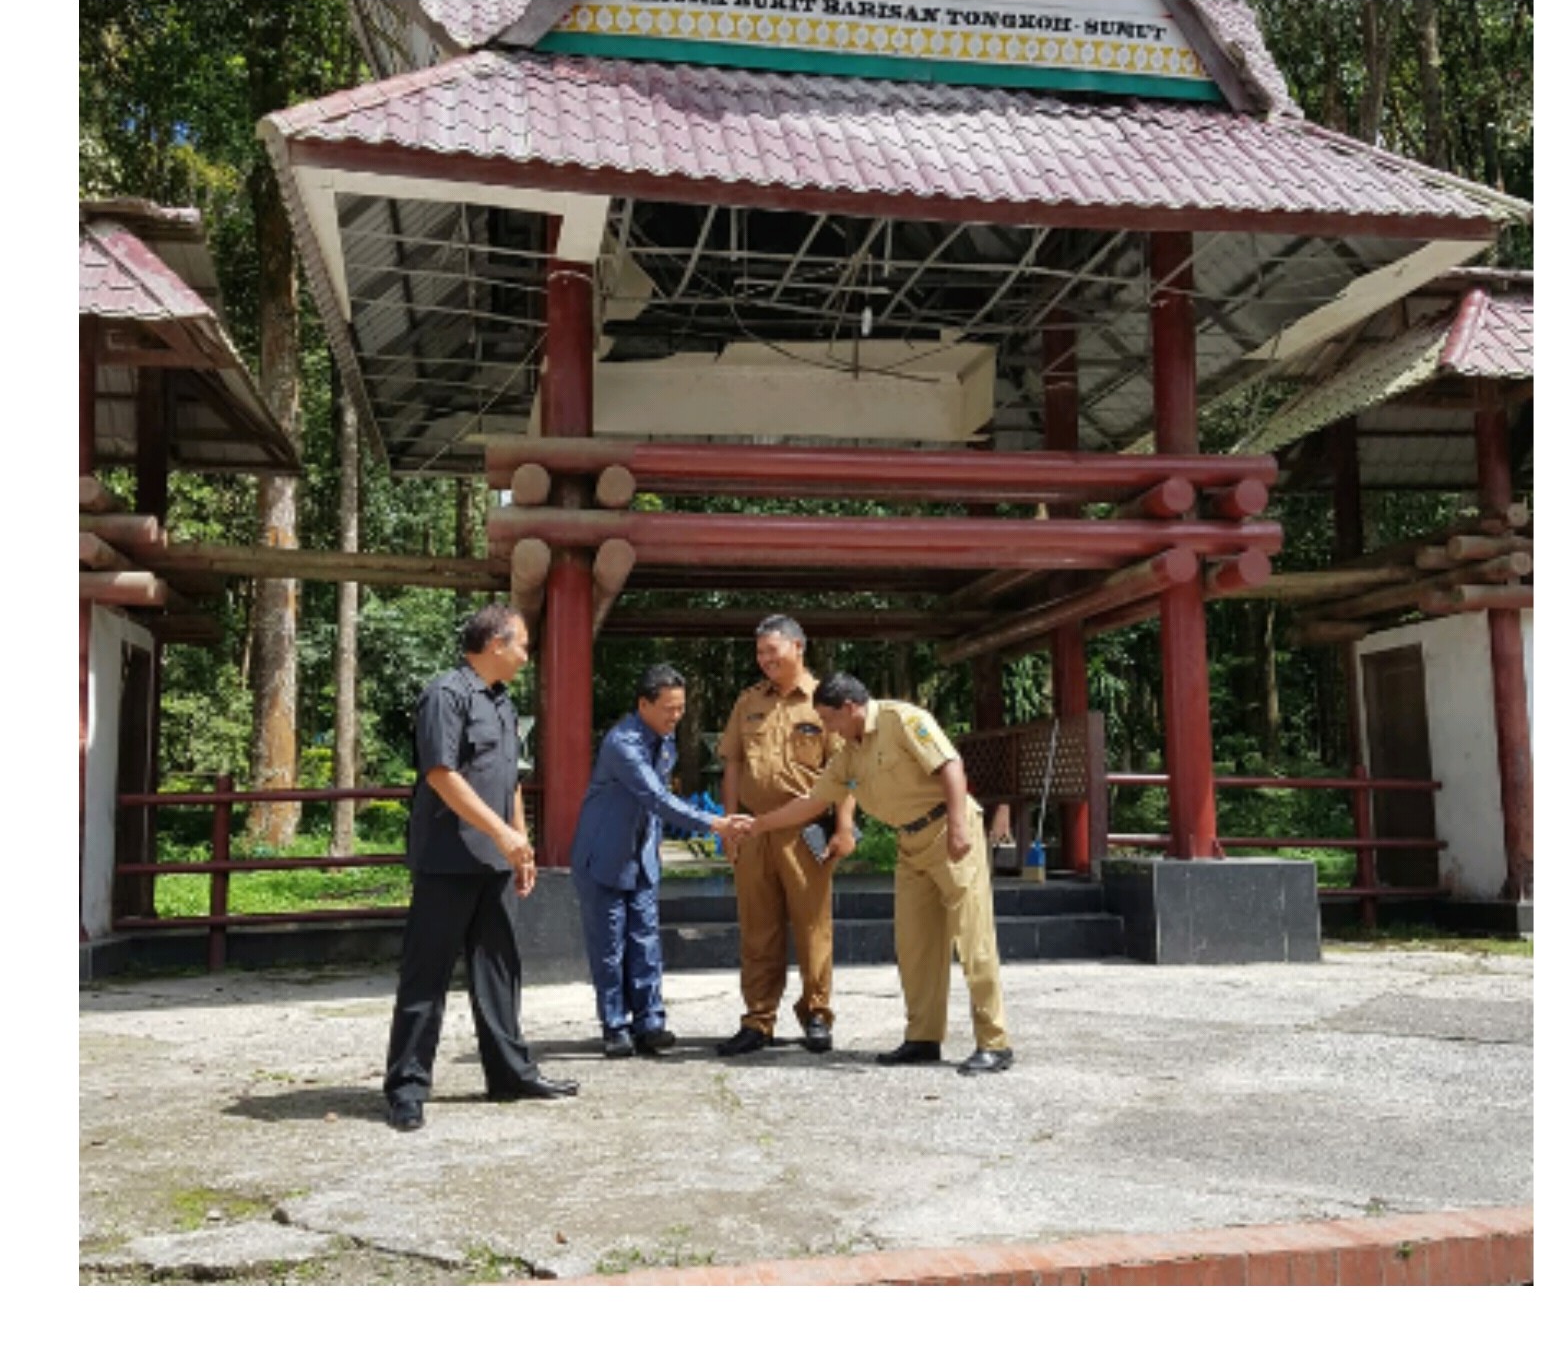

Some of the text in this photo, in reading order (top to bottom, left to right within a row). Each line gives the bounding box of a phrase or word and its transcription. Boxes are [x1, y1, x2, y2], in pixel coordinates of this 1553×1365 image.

[821, 0, 941, 23] BARISAN
[946, 8, 1072, 32] TONGKOH
[1084, 18, 1168, 41] SUMUT
